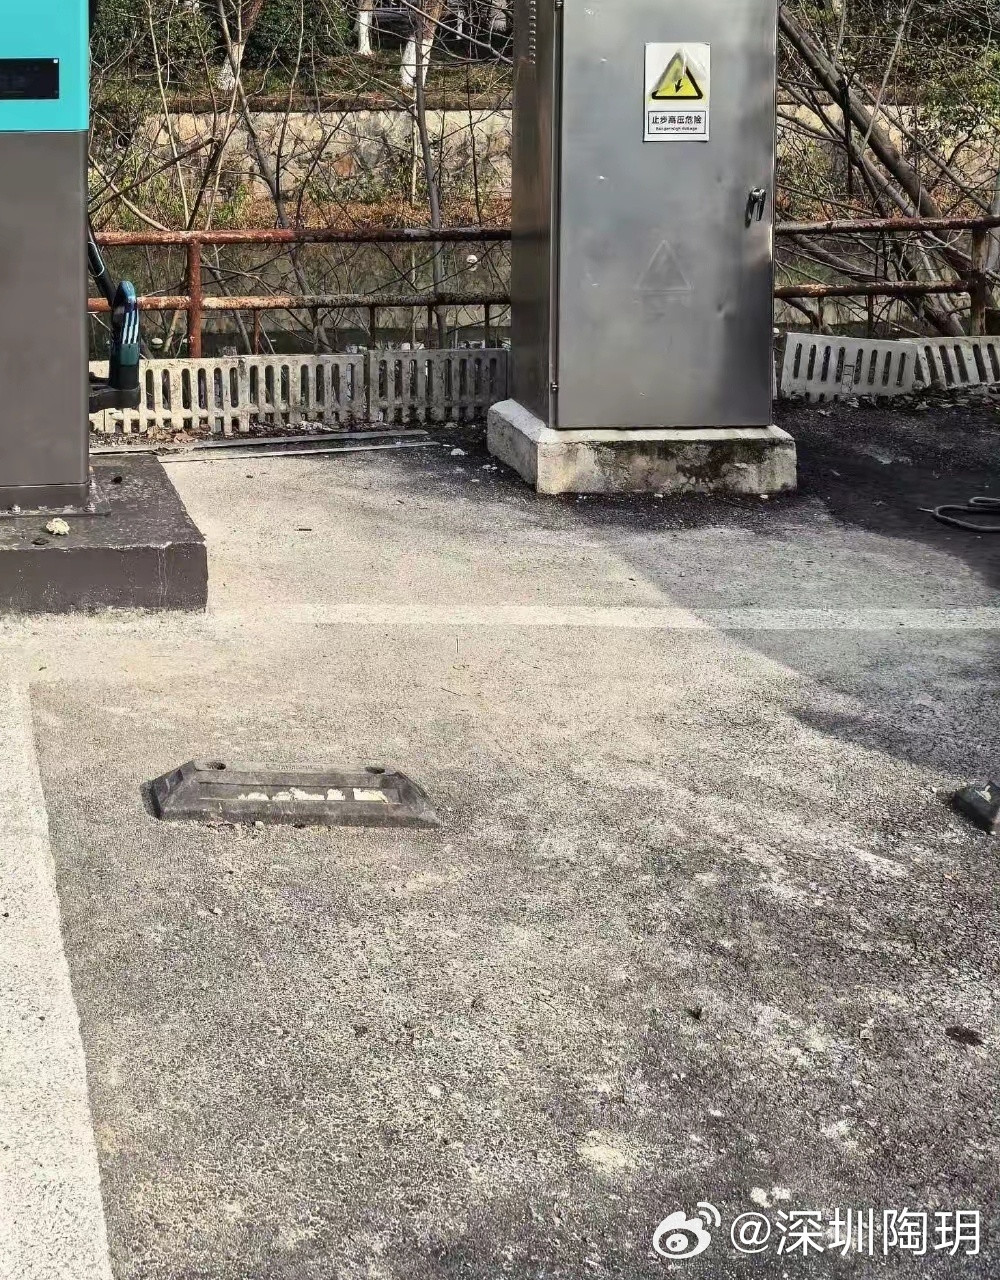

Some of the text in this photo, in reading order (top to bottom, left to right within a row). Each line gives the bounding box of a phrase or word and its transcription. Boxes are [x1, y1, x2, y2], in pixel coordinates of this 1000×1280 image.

[652, 115, 702, 124] 止步高压危险
